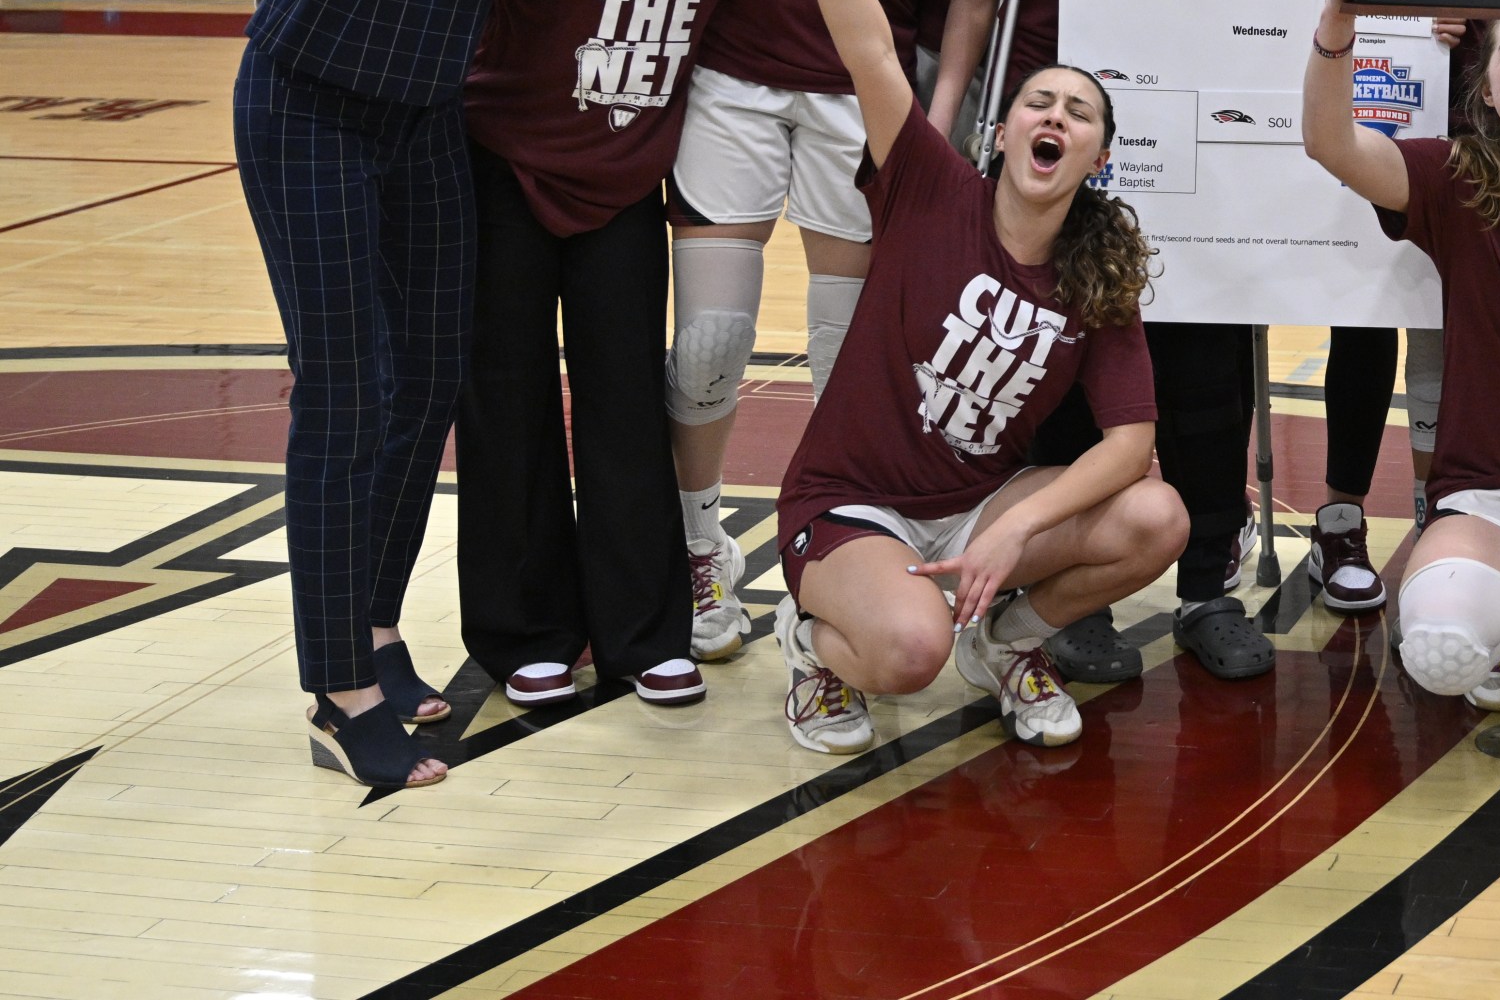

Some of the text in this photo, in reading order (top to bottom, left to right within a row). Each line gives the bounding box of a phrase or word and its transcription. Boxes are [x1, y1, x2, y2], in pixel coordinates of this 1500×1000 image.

[1232, 25, 1287, 39] Wednesday
[576, 38, 691, 95] NET
[1353, 58, 1390, 73] NAIA
[1136, 74, 1158, 84] SOU
[585, 91, 663, 102] WESTMON
[1353, 83, 1418, 103] KETBALL
[612, 109, 638, 127] W
[1376, 110, 1407, 120] ROUNDS
[1268, 117, 1292, 129] SOU
[1118, 136, 1157, 148] Tuesday
[1119, 162, 1163, 174] Wayland
[1119, 177, 1155, 188] Baptist
[1151, 234, 1191, 242] first/second
[1237, 236, 1250, 244] and
[1266, 237, 1288, 245] overall
[1332, 239, 1358, 248] seeding
[959, 273, 1067, 367] CUT
[932, 313, 1047, 408] THE
[915, 361, 1022, 446] NET
